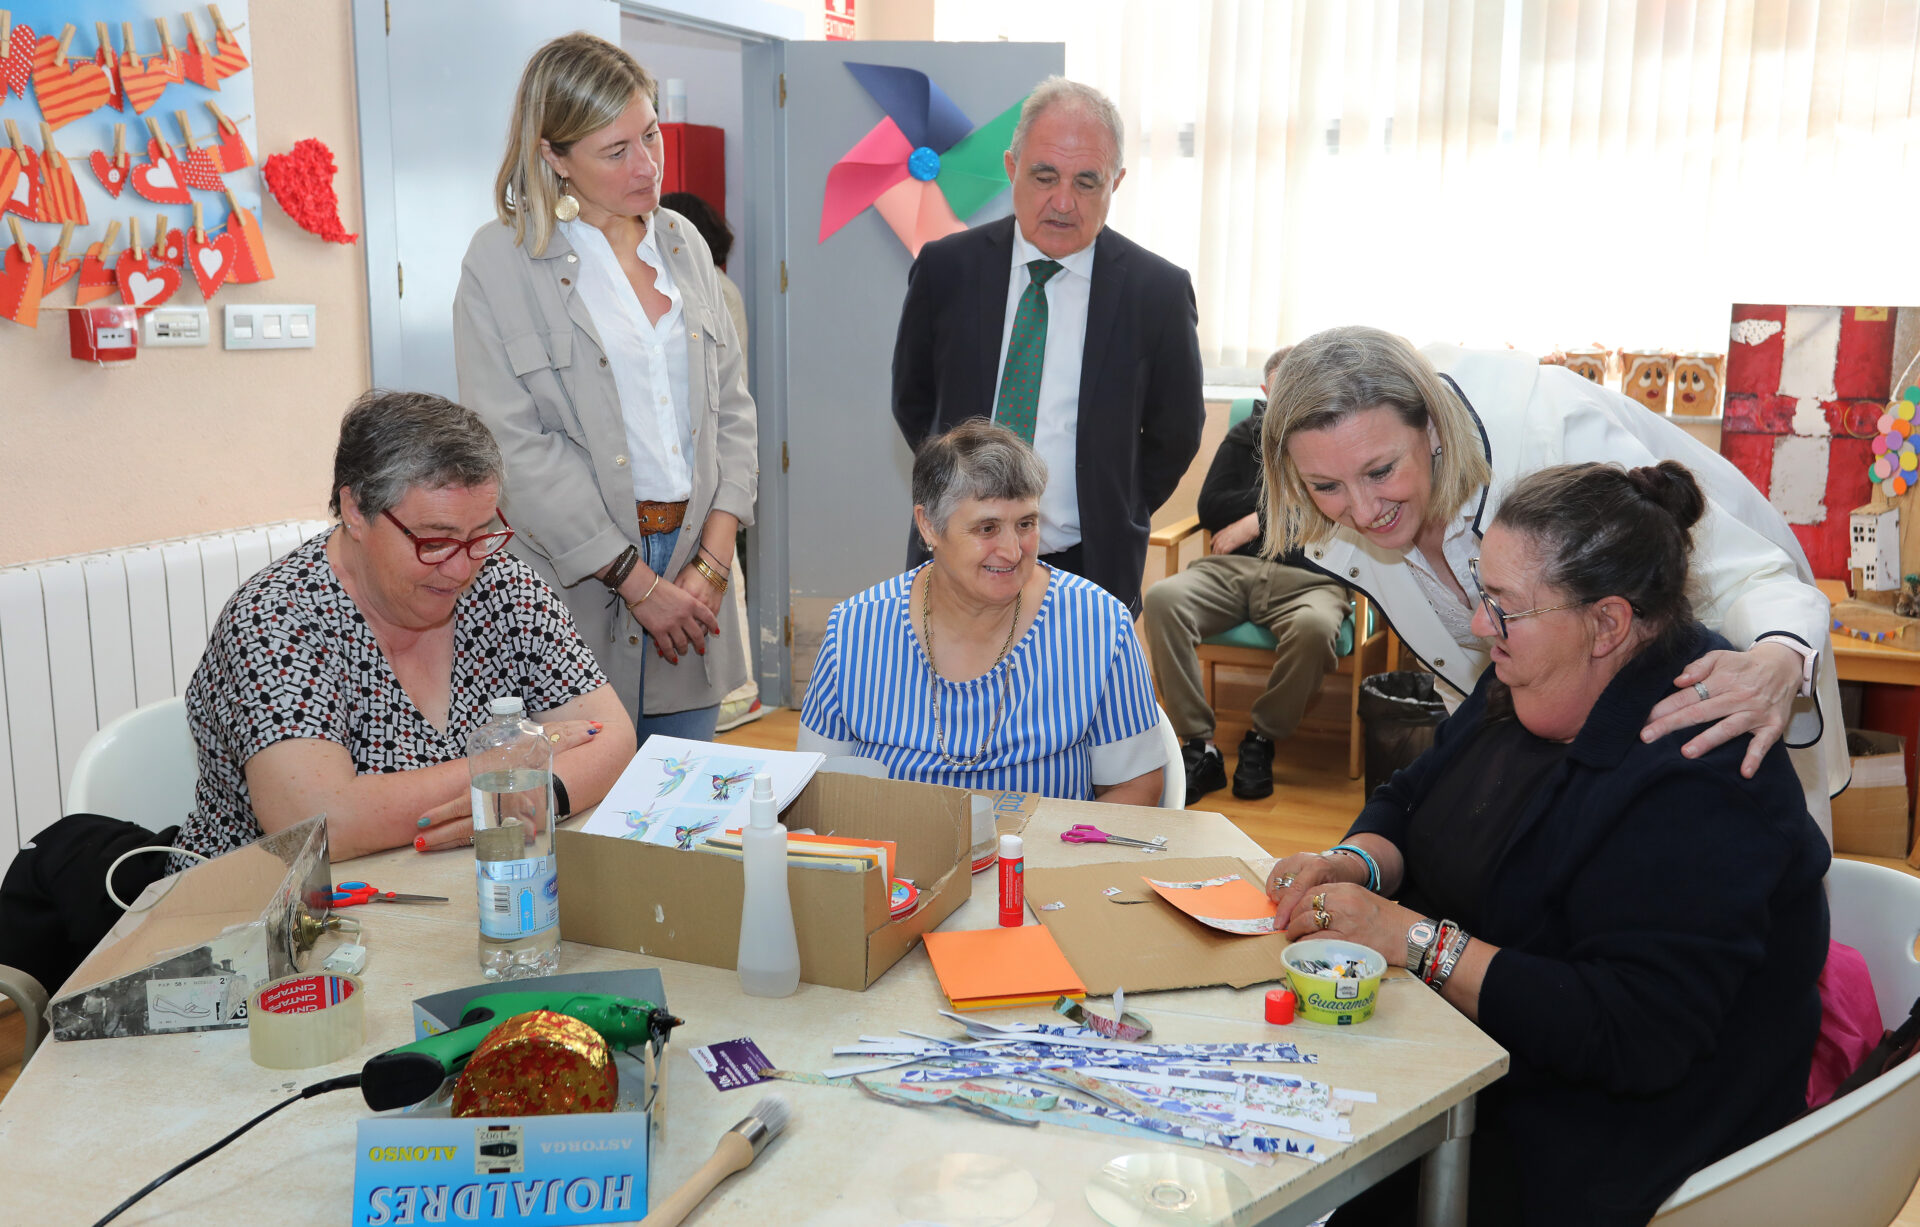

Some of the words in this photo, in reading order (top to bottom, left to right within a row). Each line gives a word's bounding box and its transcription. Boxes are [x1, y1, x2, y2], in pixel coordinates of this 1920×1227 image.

[369, 1145, 457, 1162] ALONSO
[540, 1138, 633, 1154] ASTORGA
[367, 1174, 634, 1226] HOJALDRES
